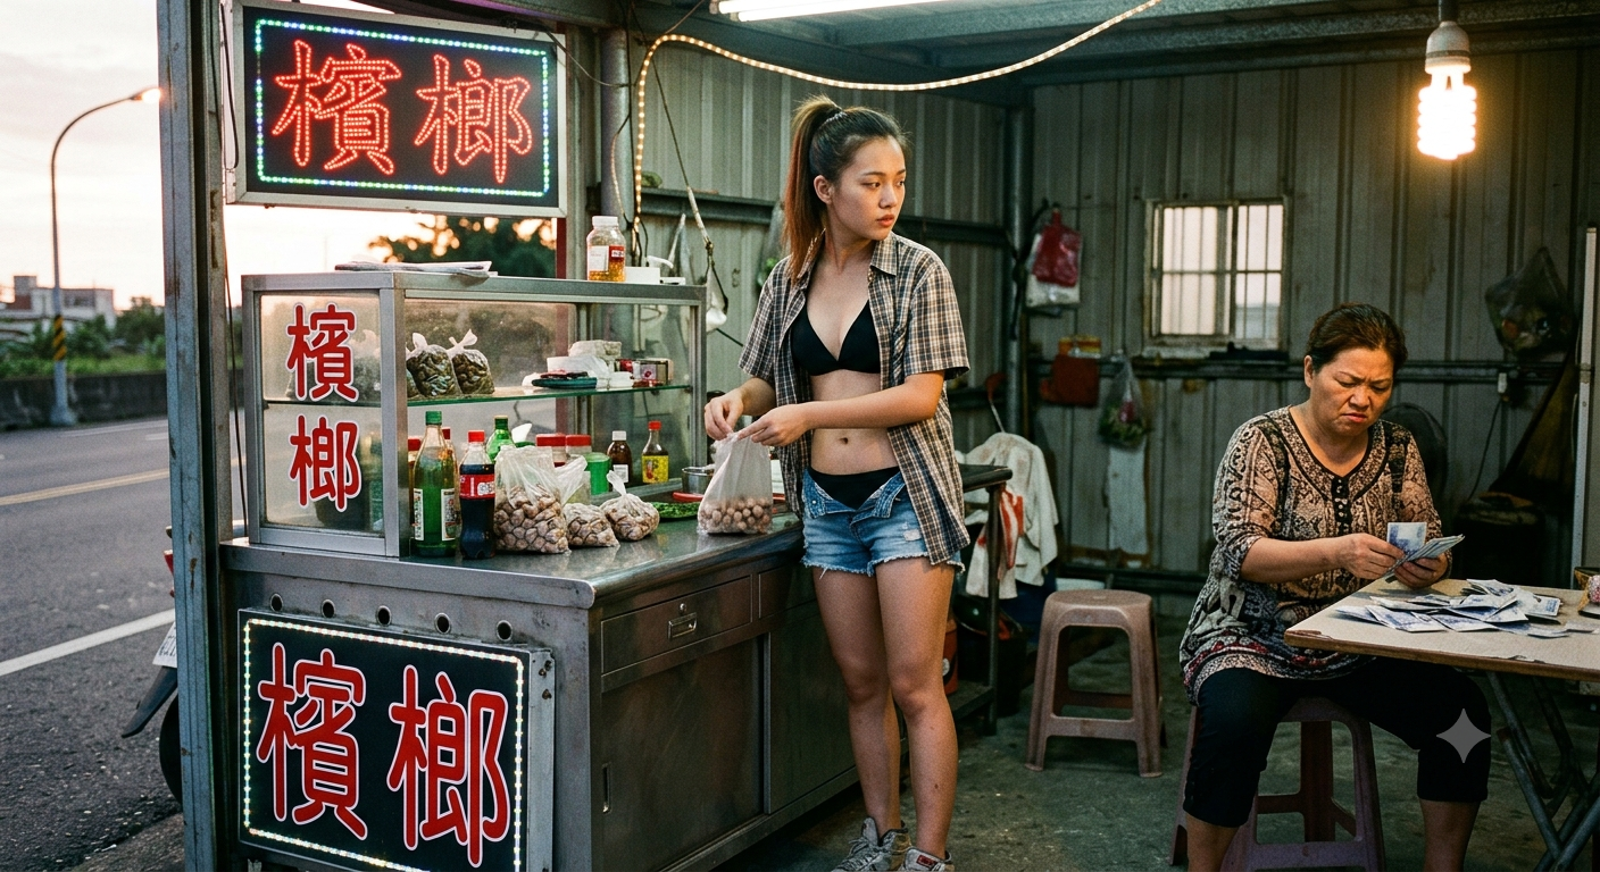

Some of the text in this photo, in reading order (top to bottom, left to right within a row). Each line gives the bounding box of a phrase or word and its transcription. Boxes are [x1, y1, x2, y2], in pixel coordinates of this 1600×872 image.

[272, 40, 532, 184] 檳榔
[286, 303, 361, 511] 檳榔
[256, 642, 510, 868] 檳榔
